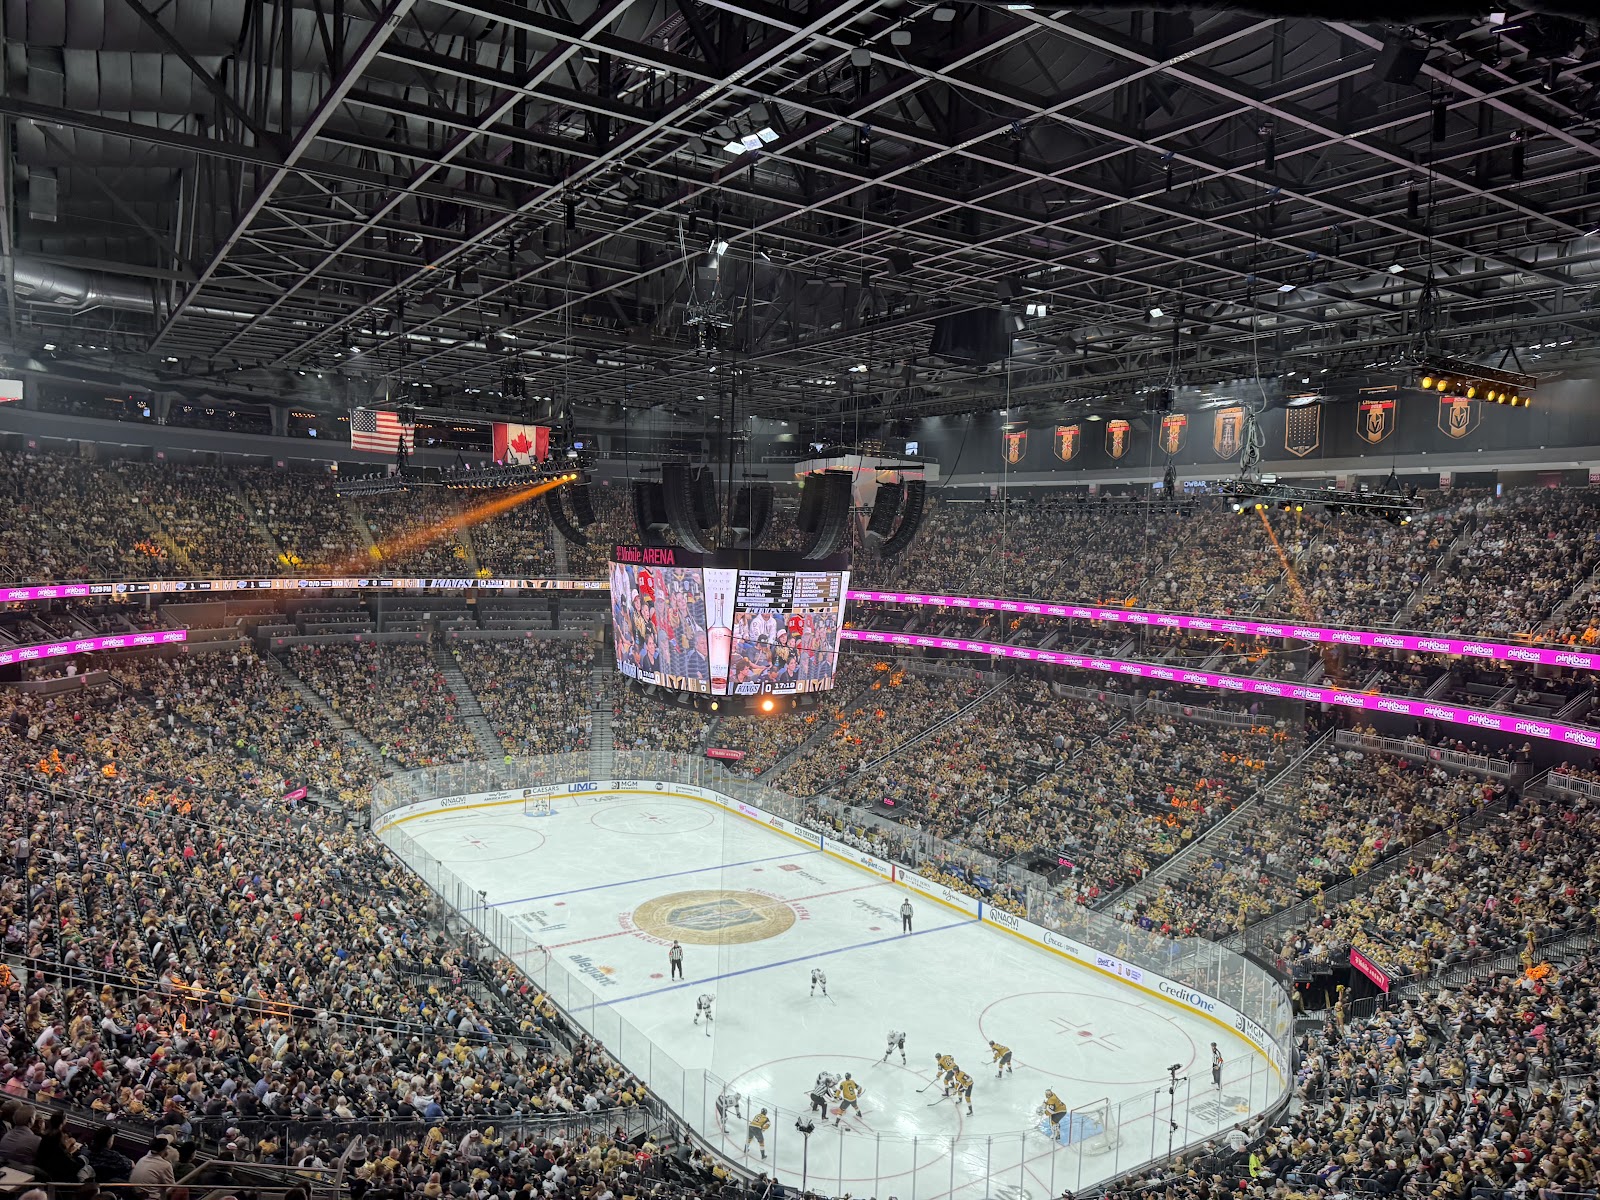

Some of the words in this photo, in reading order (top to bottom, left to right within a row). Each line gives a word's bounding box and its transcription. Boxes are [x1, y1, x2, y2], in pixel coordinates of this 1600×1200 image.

[643, 548, 675, 565] ARENA
[1222, 623, 1246, 632] pinkbox
[1257, 626, 1282, 635] pinkbox
[1294, 629, 1320, 638] pinkbox
[1332, 632, 1361, 642] pinkbox
[1374, 636, 1404, 646] pinkbox
[1418, 640, 1450, 651] pinkbox
[1463, 644, 1493, 656] pinkbox
[1508, 649, 1540, 661] pinkbox
[1556, 654, 1591, 666] pinkbox
[765, 684, 772, 692] 0
[1218, 678, 1243, 688] pinkbox
[1255, 683, 1281, 694] pinkbox
[1293, 689, 1321, 699] pinkbox
[1334, 694, 1364, 705] pinkbox
[1378, 700, 1409, 711] pinkbox
[1424, 707, 1455, 720] pinkbox
[1468, 714, 1500, 727] pinkbox
[1516, 722, 1550, 736] pinkbox
[1565, 730, 1597, 745] pinkbox
[568, 783, 597, 793] UMC
[792, 903, 810, 920] ARENA
[997, 912, 1019, 927] NAQVI
[632, 932, 673, 947] ARENA
[569, 954, 616, 986] allegiant
[1159, 981, 1214, 1012] CreditOne
[1247, 1021, 1264, 1038] MGM
